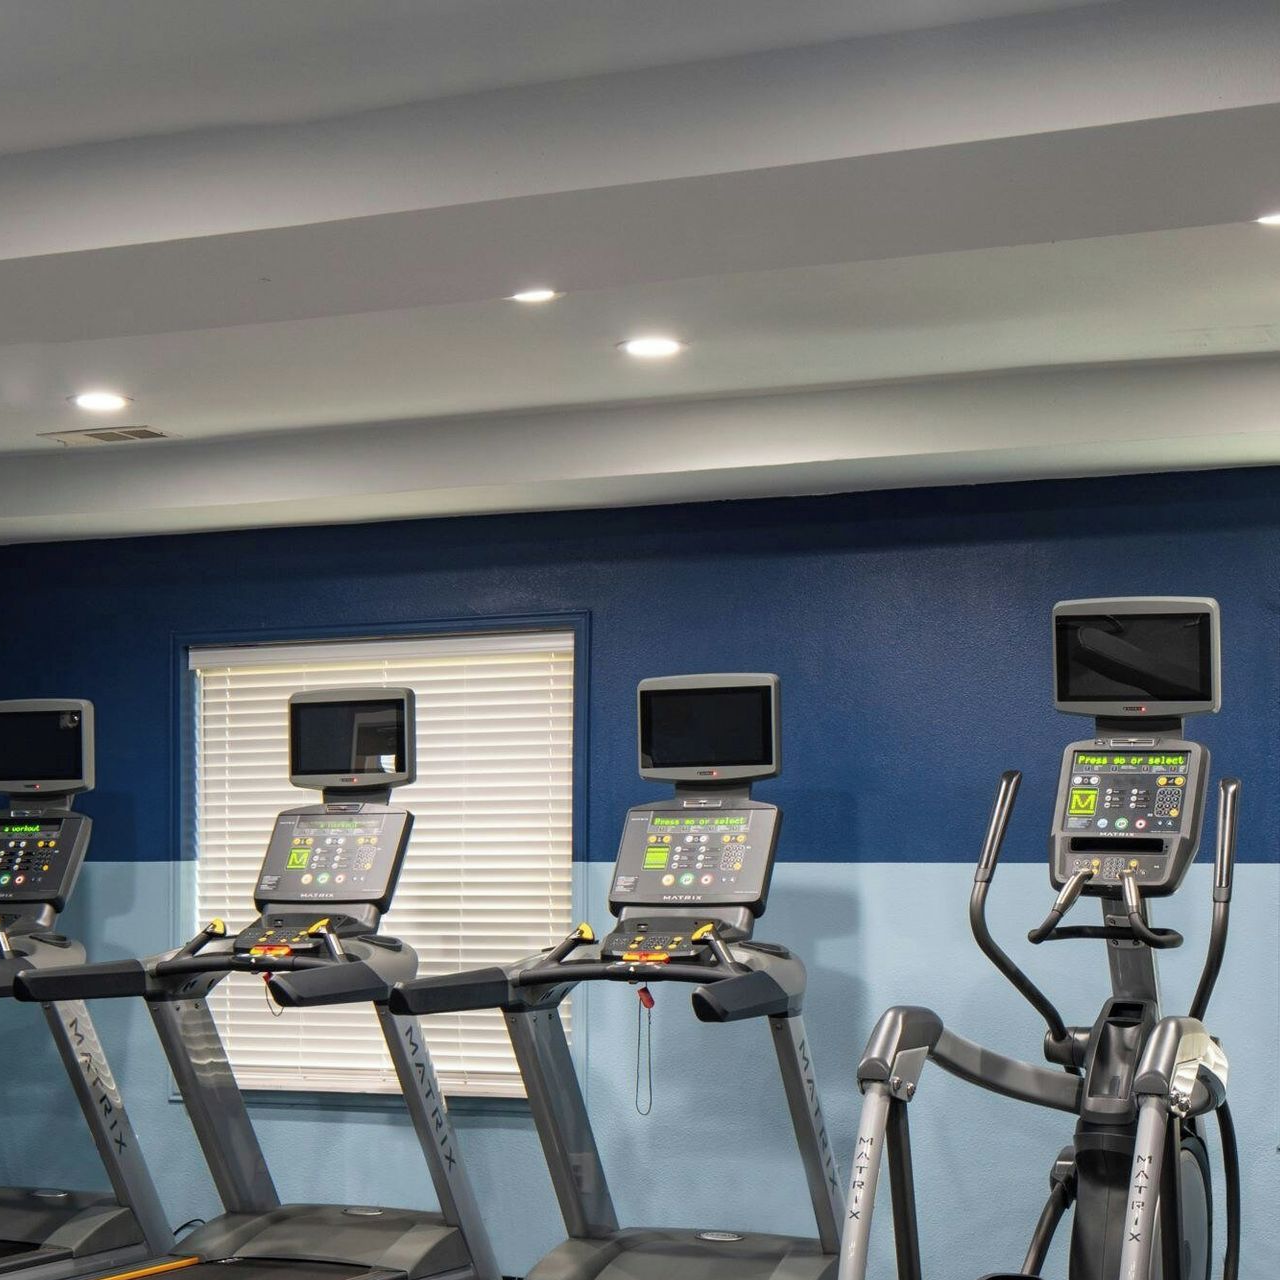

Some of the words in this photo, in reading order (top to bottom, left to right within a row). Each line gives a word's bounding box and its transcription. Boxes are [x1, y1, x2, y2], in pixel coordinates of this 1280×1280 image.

[1078, 756, 1107, 765] Press
[1131, 757, 1143, 765] or
[1148, 756, 1184, 765] select
[69, 1017, 127, 1155] MATRIX
[405, 1025, 456, 1173] MATRIX
[799, 1039, 838, 1195] MATRIX
[848, 1136, 874, 1220] MATRIX
[1128, 1155, 1152, 1242] MATRIX
